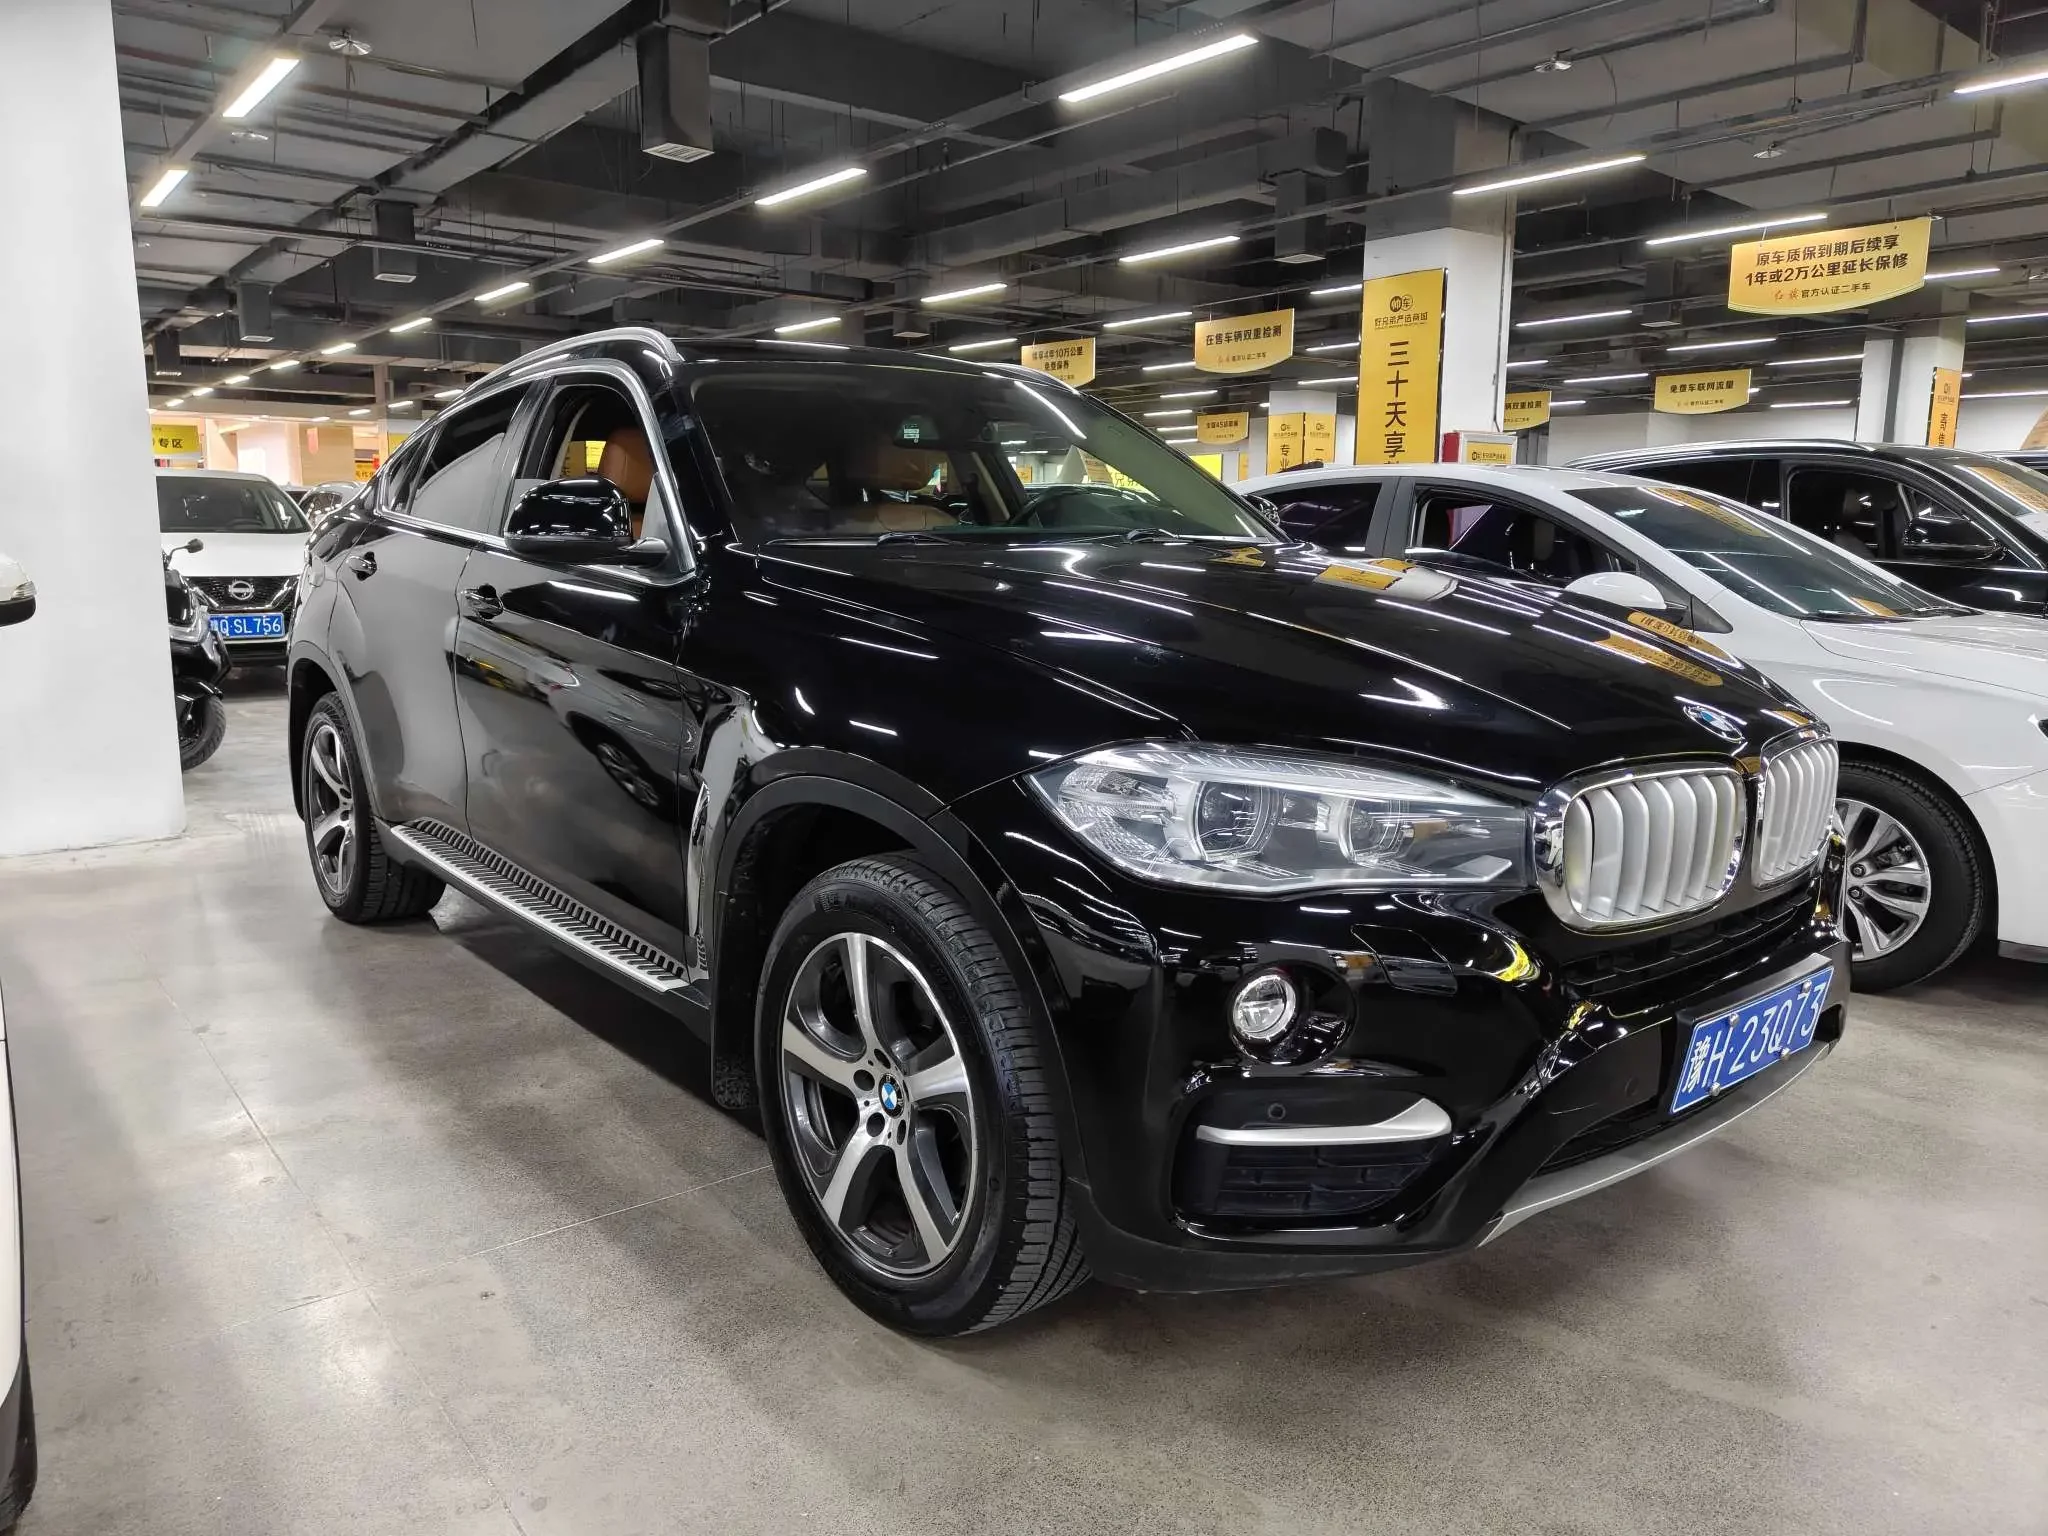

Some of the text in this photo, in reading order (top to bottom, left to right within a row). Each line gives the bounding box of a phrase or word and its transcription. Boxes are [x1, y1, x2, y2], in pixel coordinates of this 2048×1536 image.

[1756, 234, 1900, 266] 原车质保到期后续享
[1745, 253, 1909, 286] 1年或2万公里延长保修
[1206, 325, 1282, 346] 在售车辆双重检测
[1384, 340, 1409, 464] 三十天享
